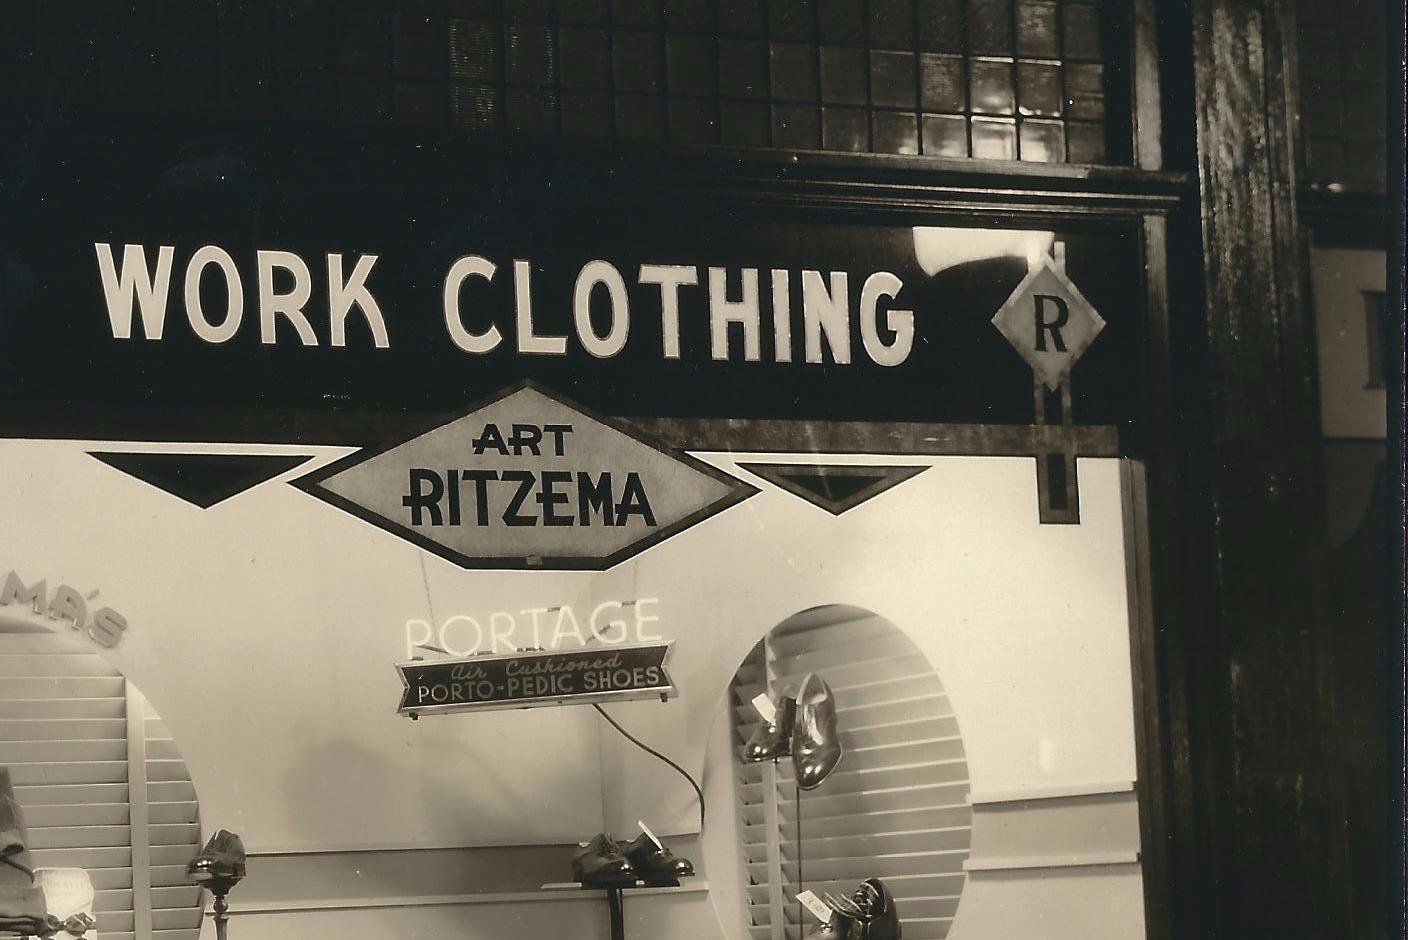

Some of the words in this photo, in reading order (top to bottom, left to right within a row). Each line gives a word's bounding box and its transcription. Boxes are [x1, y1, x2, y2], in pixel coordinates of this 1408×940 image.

[94, 242, 391, 349] WORK
[442, 254, 915, 367] CLOTHING
[1033, 293, 1070, 354] R
[471, 422, 574, 457] ART
[401, 468, 658, 528] RITZEMA
[404, 598, 663, 661] PORTAGE
[417, 673, 575, 704] PORTO-PEDIC
[583, 665, 661, 690] SHOES
[450, 664, 488, 681] Air
[505, 652, 625, 677] Cushioned
